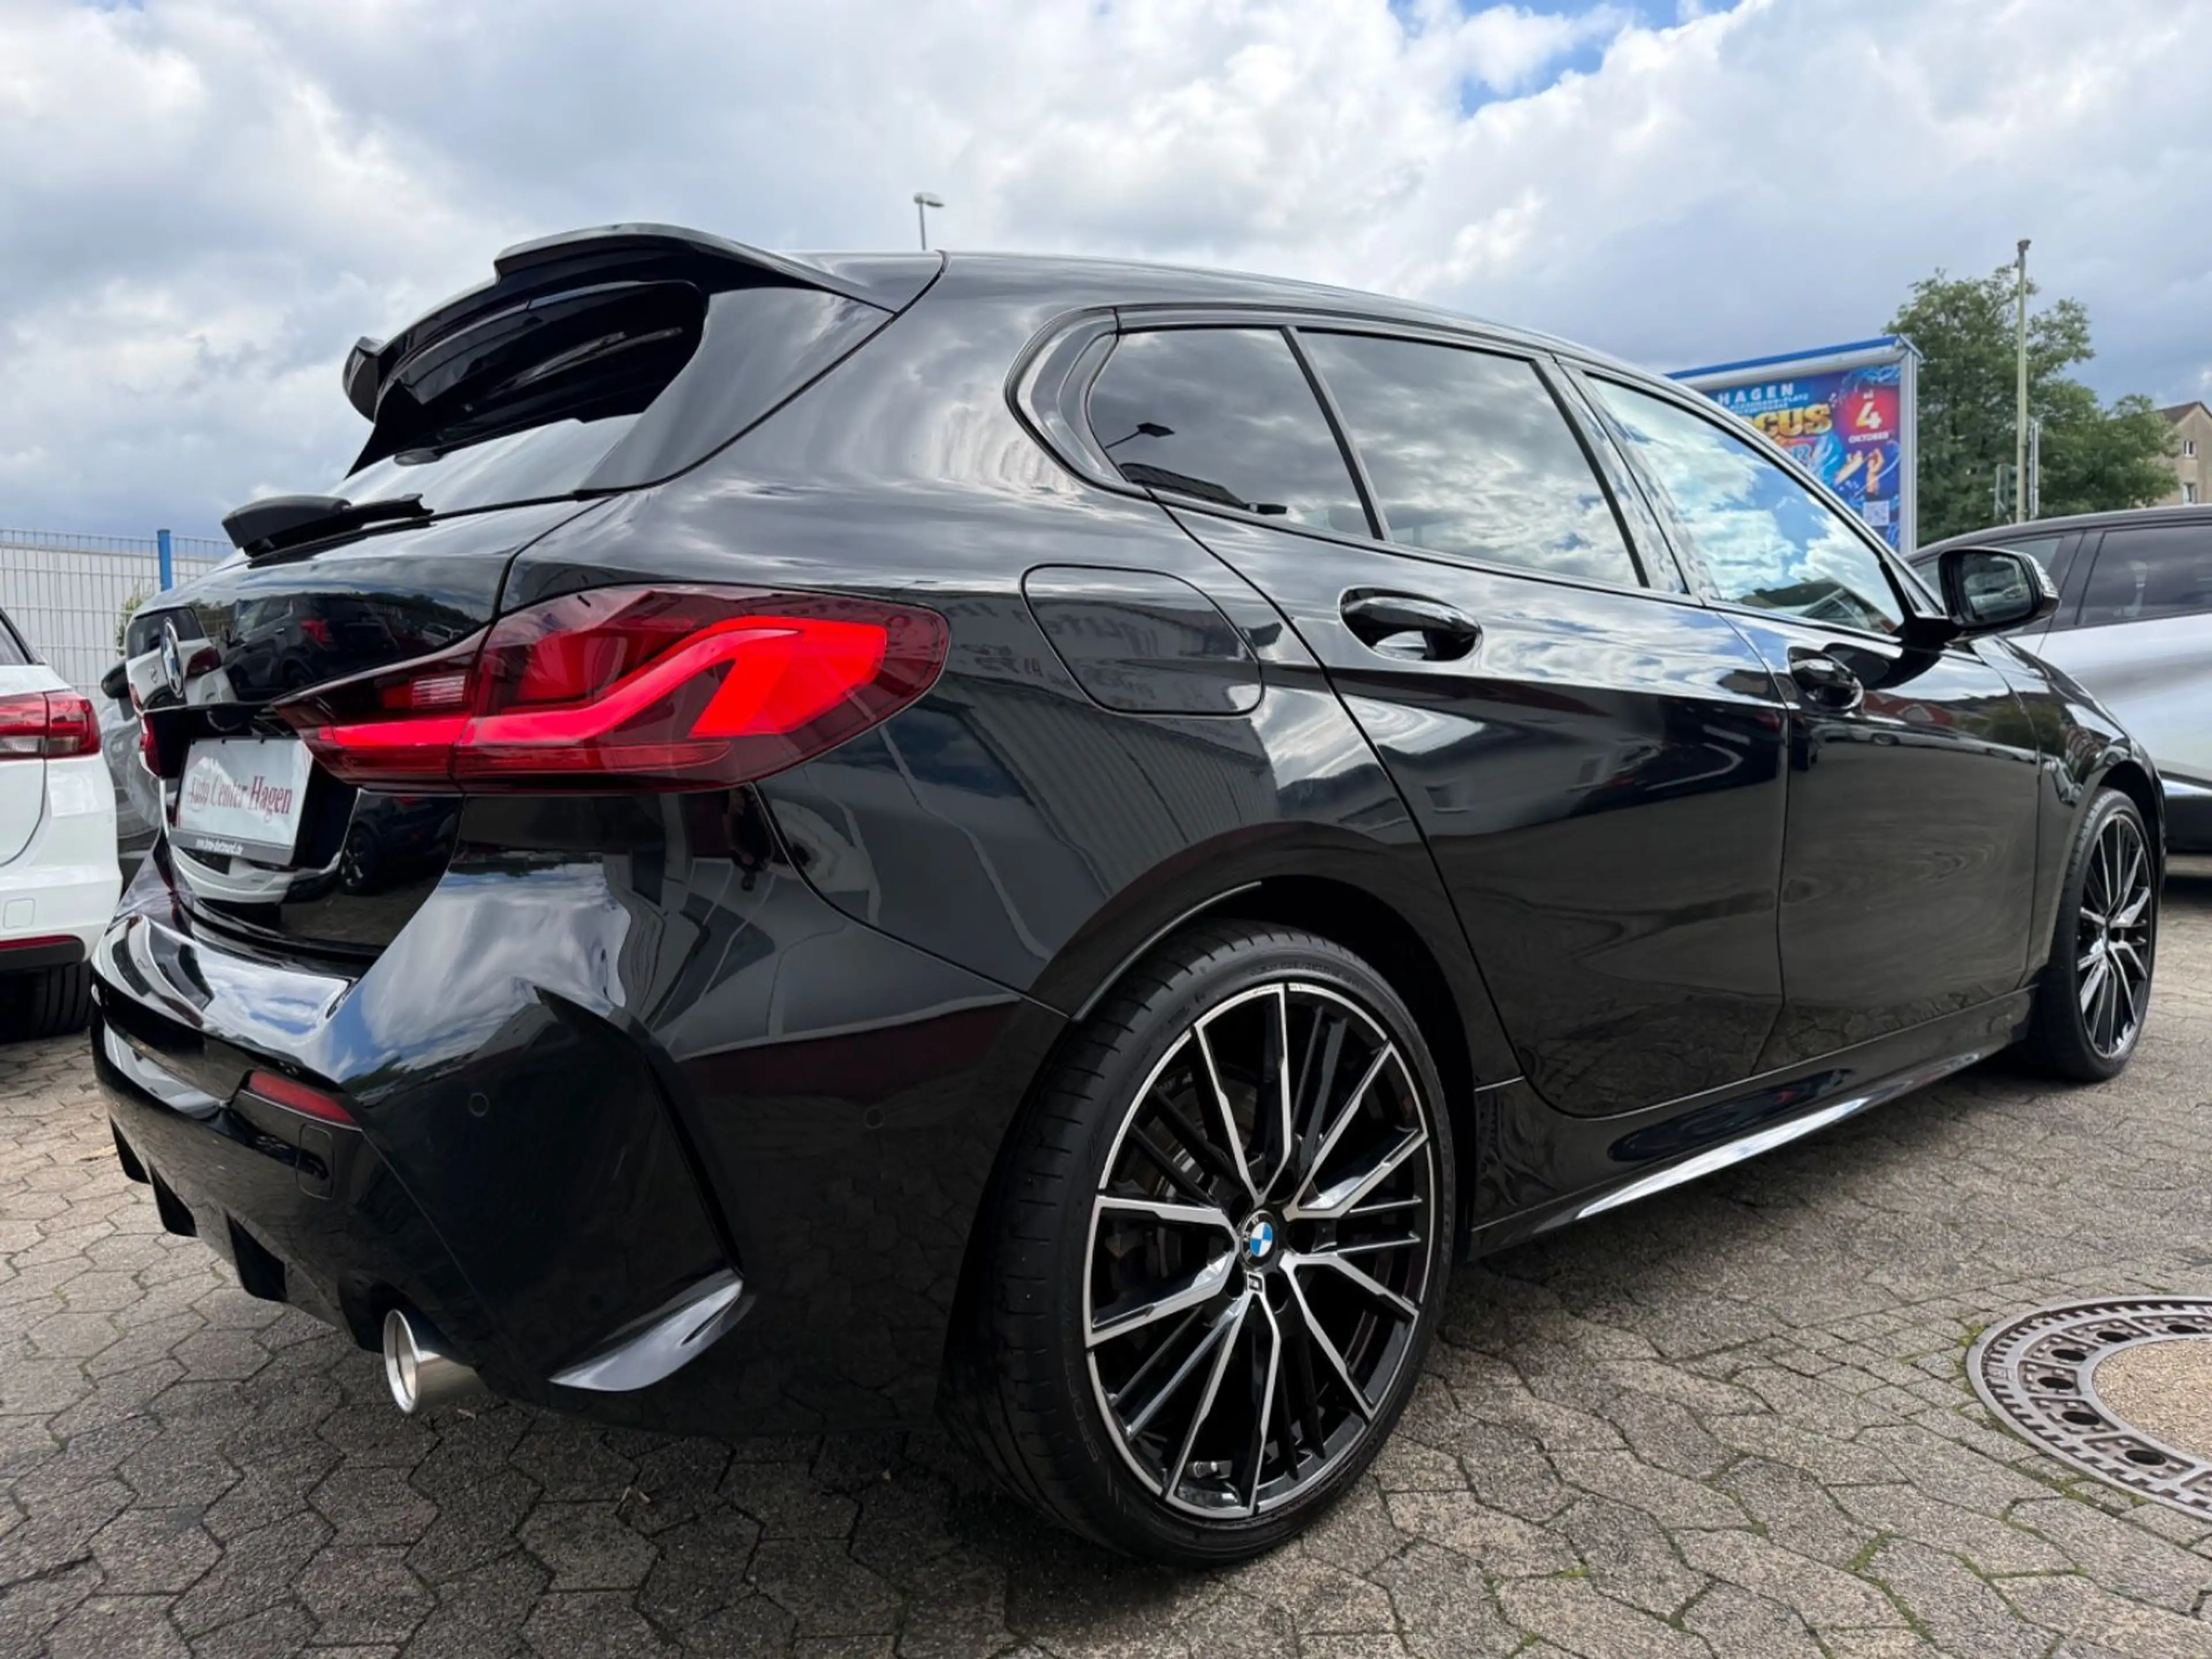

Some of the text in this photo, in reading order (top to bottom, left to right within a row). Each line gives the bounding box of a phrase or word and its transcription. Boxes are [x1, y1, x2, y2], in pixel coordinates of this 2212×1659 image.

[1718, 382, 1794, 406] HAGEN
[1855, 401, 1883, 430] 4
[250, 775, 293, 820] Hagen
